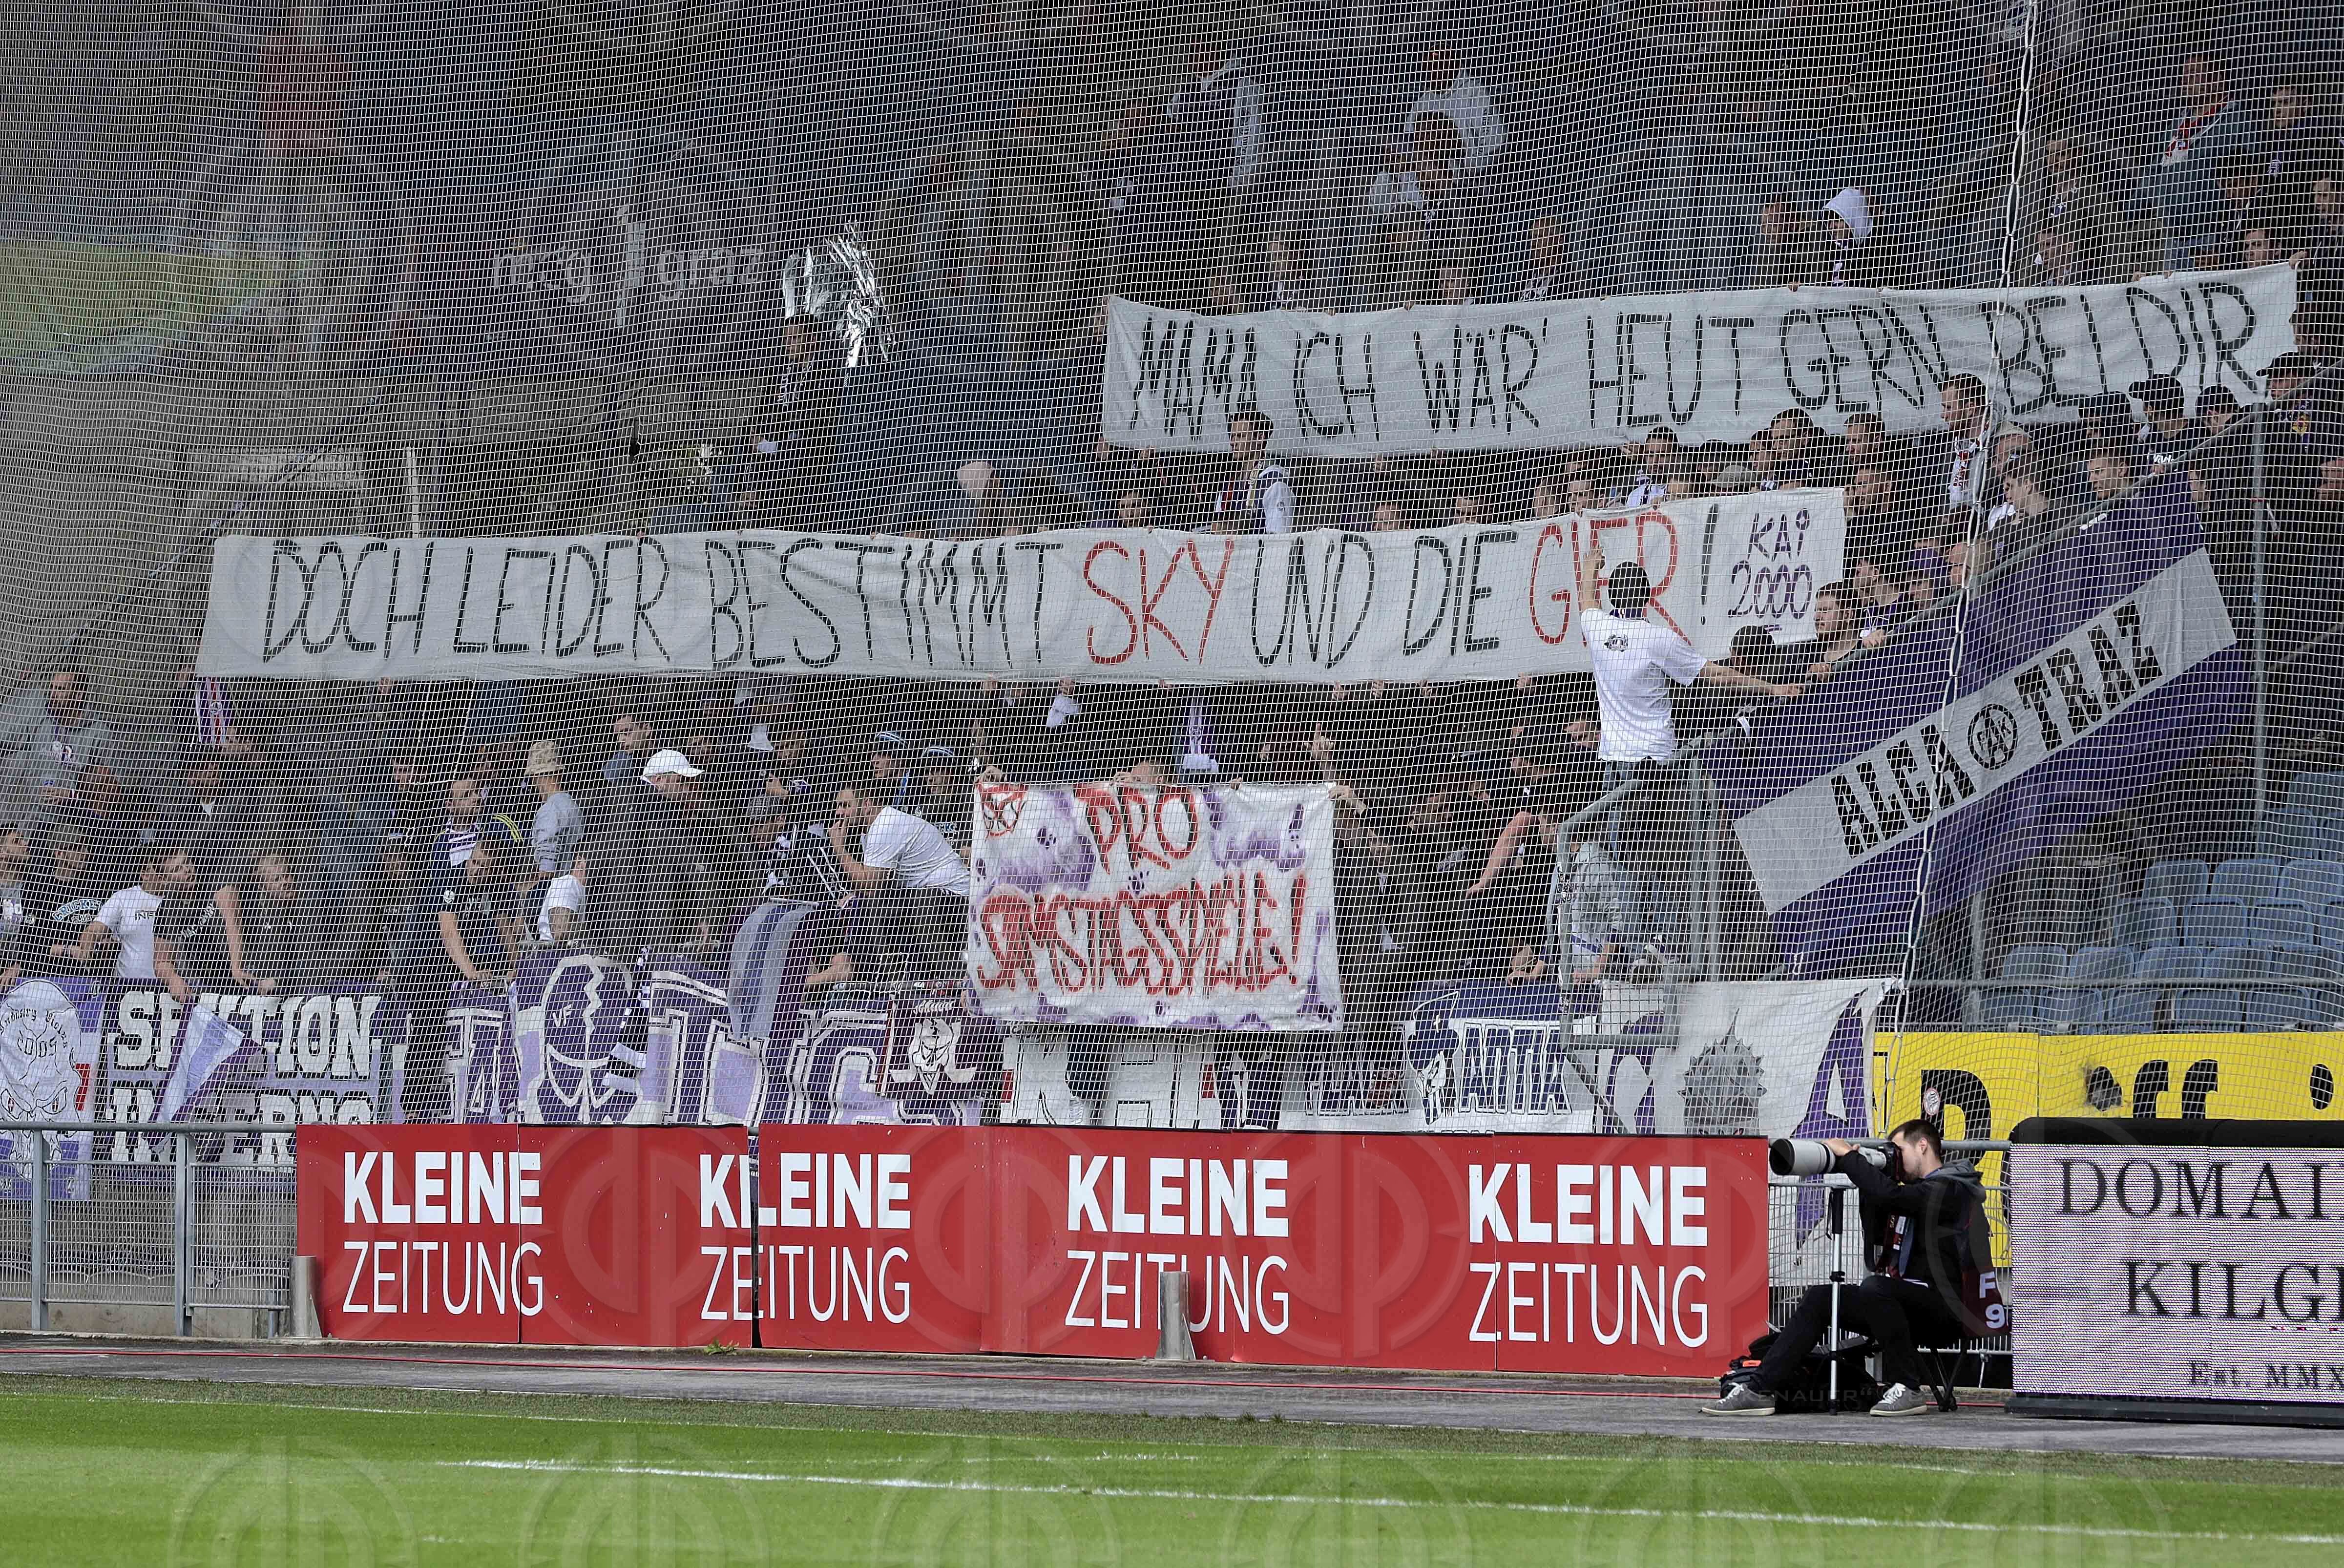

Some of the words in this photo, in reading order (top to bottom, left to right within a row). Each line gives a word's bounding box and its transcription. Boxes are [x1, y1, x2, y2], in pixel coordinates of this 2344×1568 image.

[657, 247, 766, 302] graz
[1130, 316, 1257, 440] MAMA
[1294, 330, 1379, 440] ICH
[1588, 311, 1754, 428] HEUT
[1779, 302, 1949, 414] GERN
[1981, 294, 2108, 415] BEI
[2126, 282, 2259, 397] DIR
[263, 540, 434, 663] DOCH
[453, 537, 670, 661] LEIDER
[705, 537, 1063, 669] BESTIMMT
[1084, 539, 1235, 666] SKY
[1251, 533, 1375, 669] UND
[1402, 529, 1519, 656] DIE
[1727, 559, 1812, 619] 2000
[2013, 602, 2163, 752] TRAZ
[1074, 783, 1200, 875] PRO
[344, 1151, 543, 1225] KLEINE
[700, 1152, 911, 1230] KLEINE
[1067, 1154, 1289, 1237] KLEINE
[1469, 1163, 1708, 1247] KLEINE
[342, 1241, 544, 1317] ZEITUNG
[700, 1245, 910, 1324] ZEITUNG
[1065, 1249, 1290, 1336] ZEITUNG
[1469, 1261, 1708, 1349] ZEITUNG
[2120, 1259, 2344, 1322] KILG
